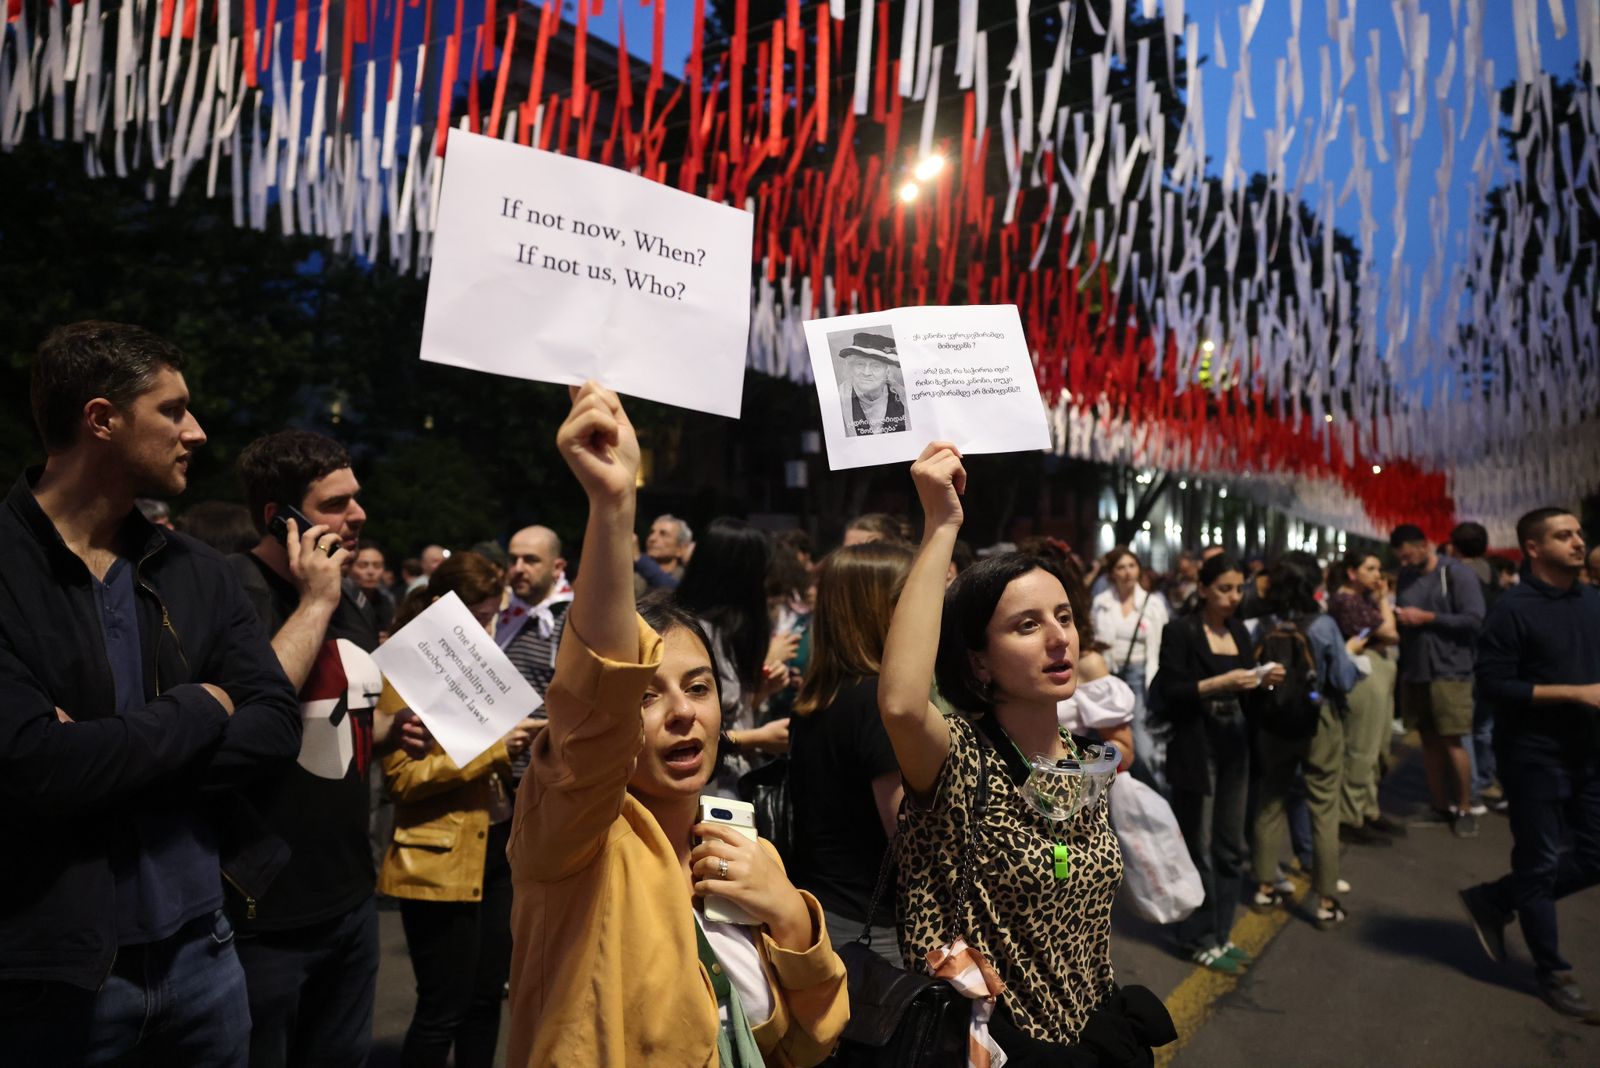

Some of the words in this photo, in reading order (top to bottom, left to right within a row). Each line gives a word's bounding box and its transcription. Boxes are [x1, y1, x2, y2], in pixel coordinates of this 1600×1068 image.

[501, 197, 523, 219] If
[526, 208, 565, 231] not
[571, 219, 626, 247] now,
[633, 229, 706, 267] When?
[516, 243, 539, 265] If
[542, 254, 581, 276] not
[587, 264, 617, 285] us,
[625, 268, 686, 301] Who?
[417, 641, 446, 675] disobey
[444, 673, 468, 702] unjust
[466, 700, 490, 725] laws!
[438, 637, 487, 695] responsibility
[484, 693, 495, 706] to
[453, 625, 470, 646] One
[469, 643, 482, 664] has
[480, 661, 487, 669] a
[486, 667, 511, 694] moral
